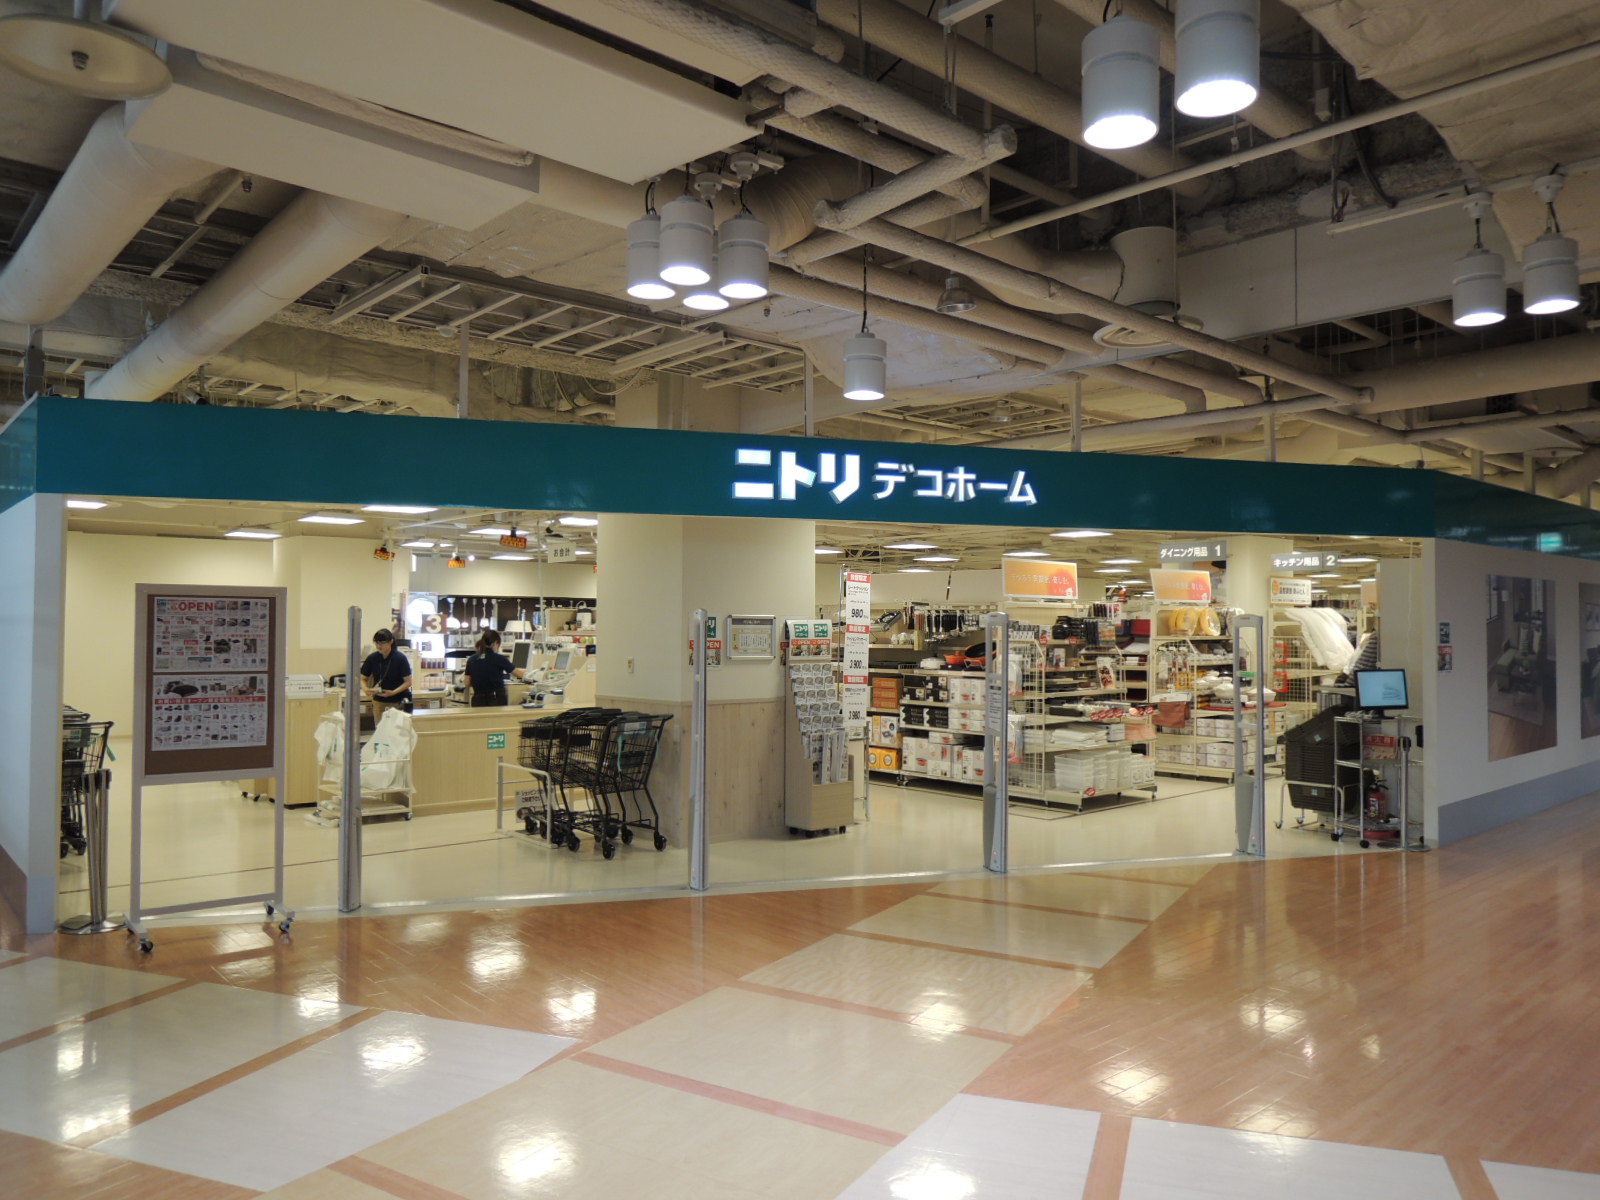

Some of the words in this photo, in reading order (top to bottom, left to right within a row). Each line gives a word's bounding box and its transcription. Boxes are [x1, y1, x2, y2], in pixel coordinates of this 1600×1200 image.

[731, 449, 861, 504] ニトリ
[872, 462, 1039, 506] デコホーム
[1160, 546, 1208, 559] ダイニング用品
[1214, 545, 1222, 557] 1
[1273, 557, 1320, 568] キッチン用品
[1326, 555, 1336, 567] 2
[178, 601, 214, 612] OPEN
[851, 608, 864, 619] 980
[425, 614, 442, 634] 3
[488, 735, 504, 743] ニトリ
